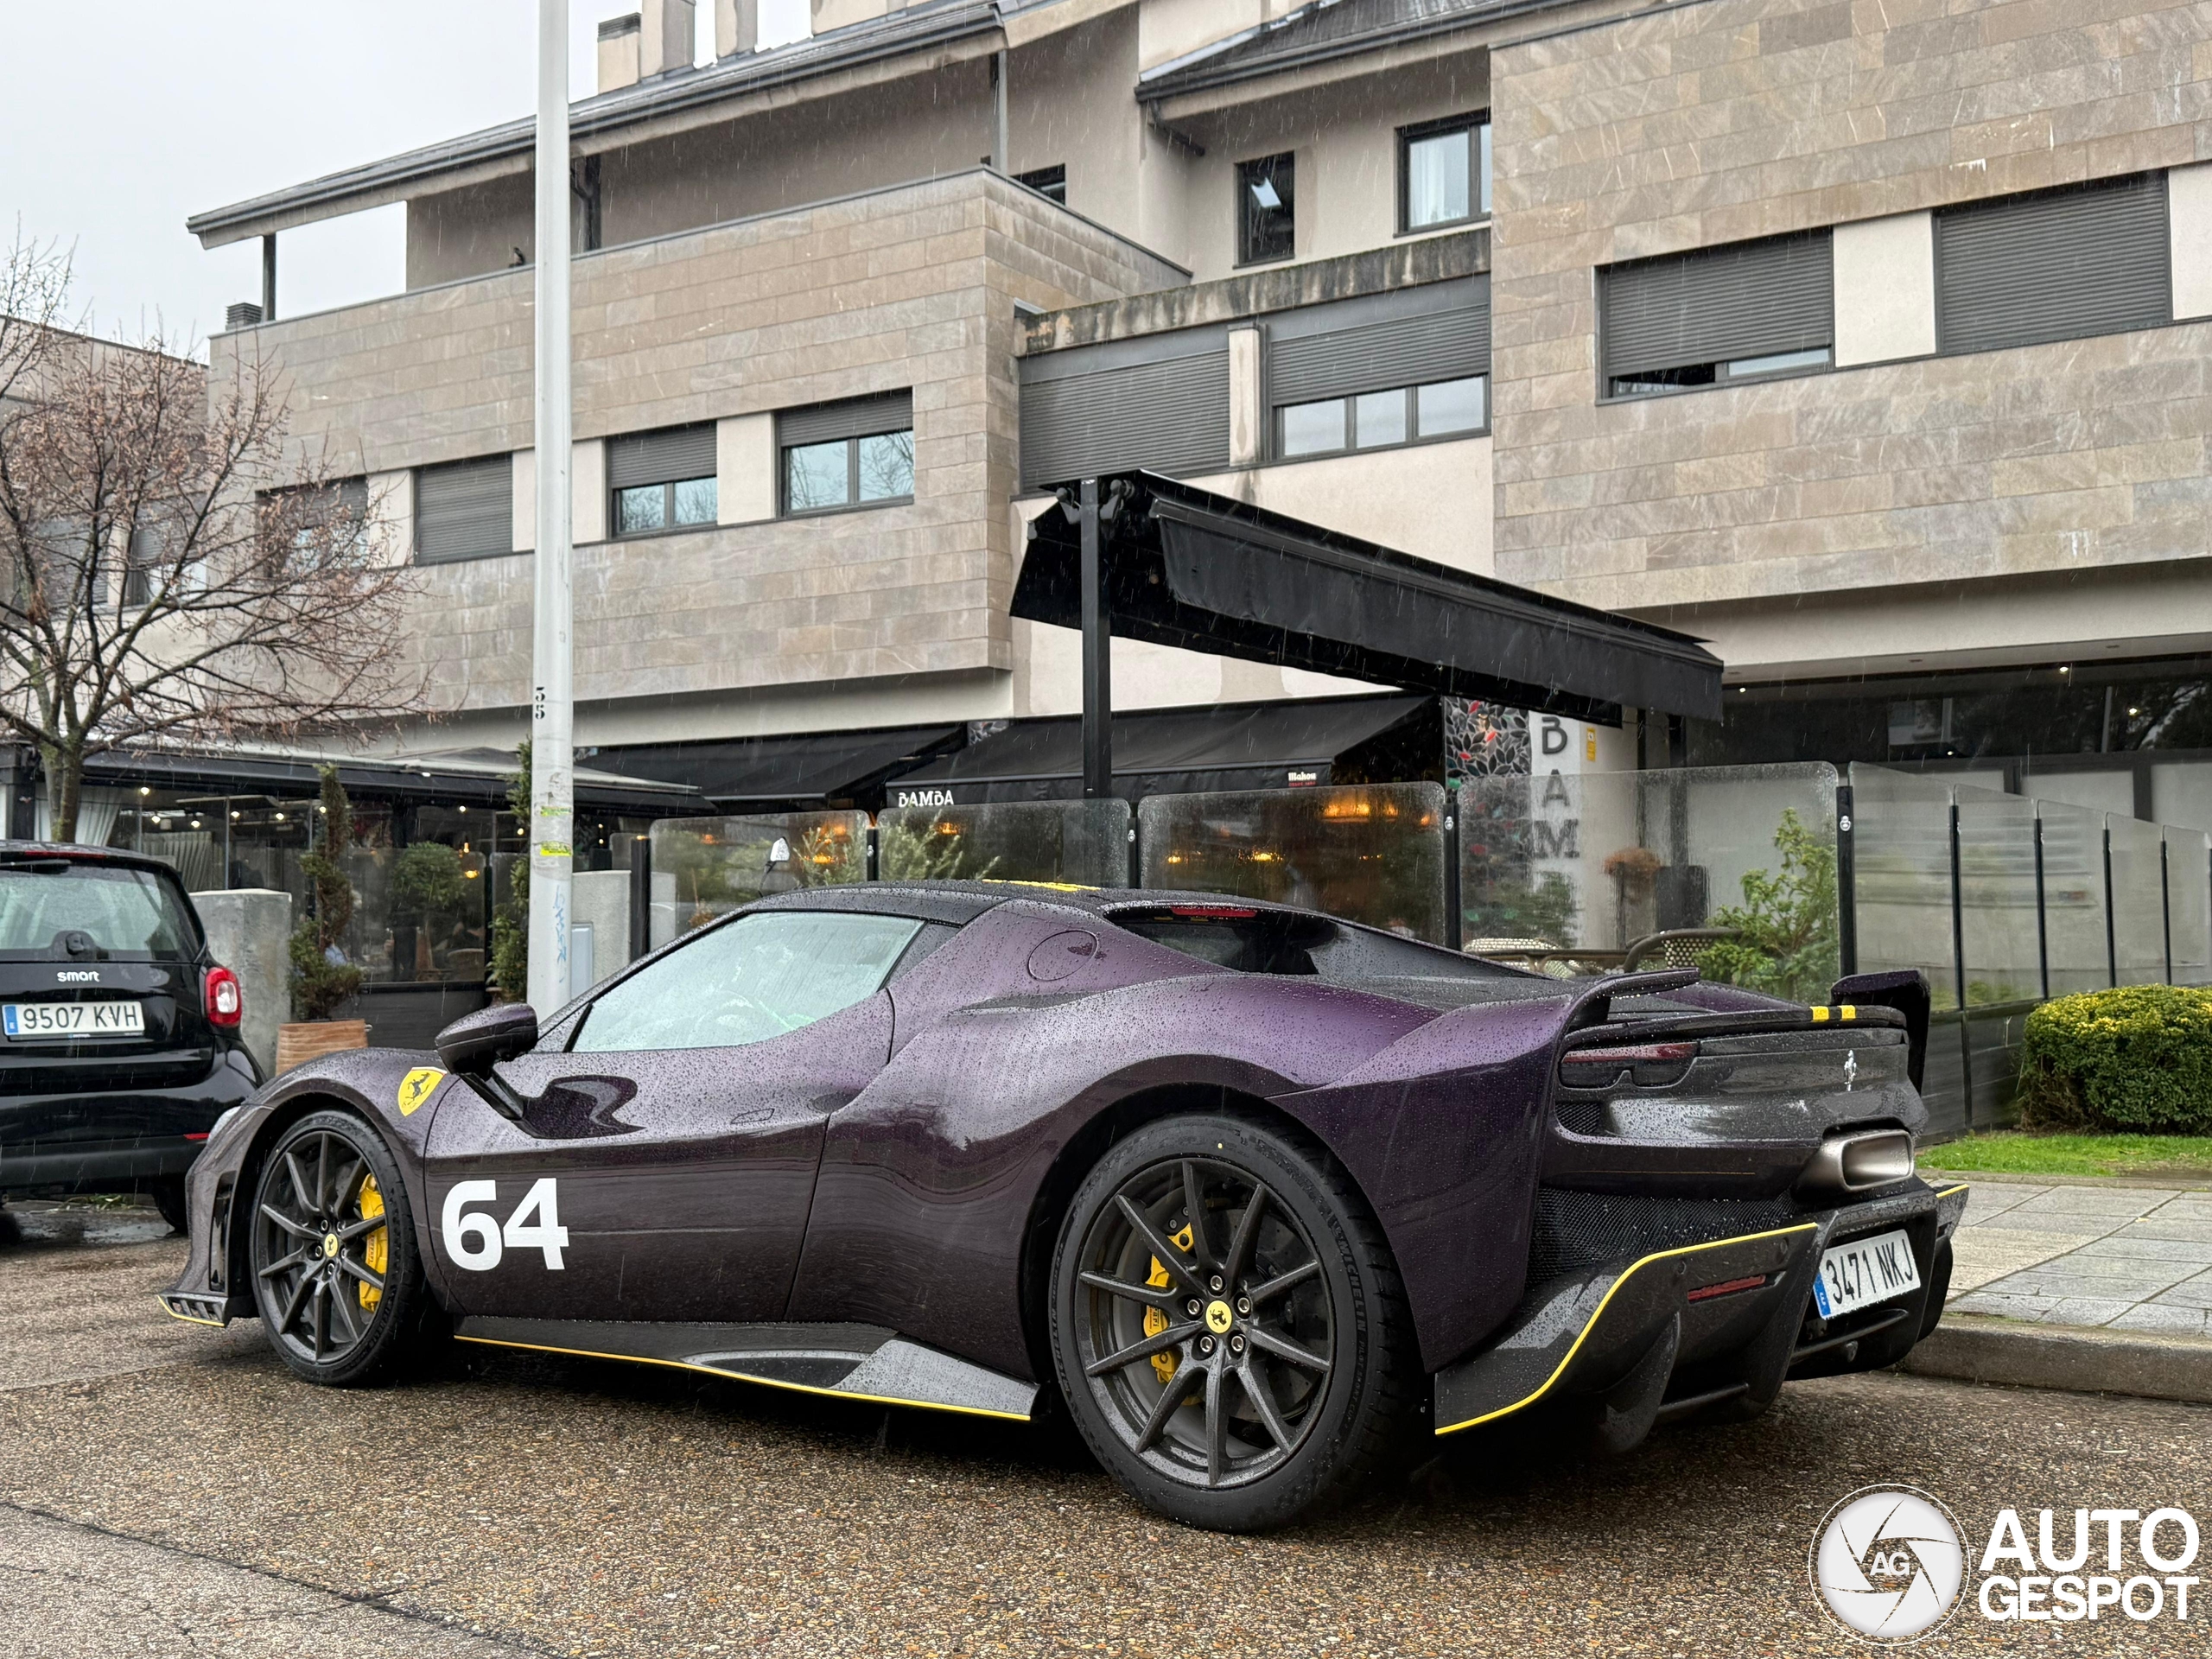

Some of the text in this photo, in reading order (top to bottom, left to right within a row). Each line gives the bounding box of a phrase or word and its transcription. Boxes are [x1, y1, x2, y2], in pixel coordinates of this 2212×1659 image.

[899, 790, 954, 808] BAMBA
[57, 971, 100, 982] smart
[23, 1007, 84, 1029] 9507
[94, 1005, 138, 1028] KVH
[442, 1178, 569, 1271] 64
[1338, 1239, 1367, 1332] MICHELIN
[1826, 1249, 1877, 1305] 3471
[1875, 1238, 1913, 1289] NKJ
